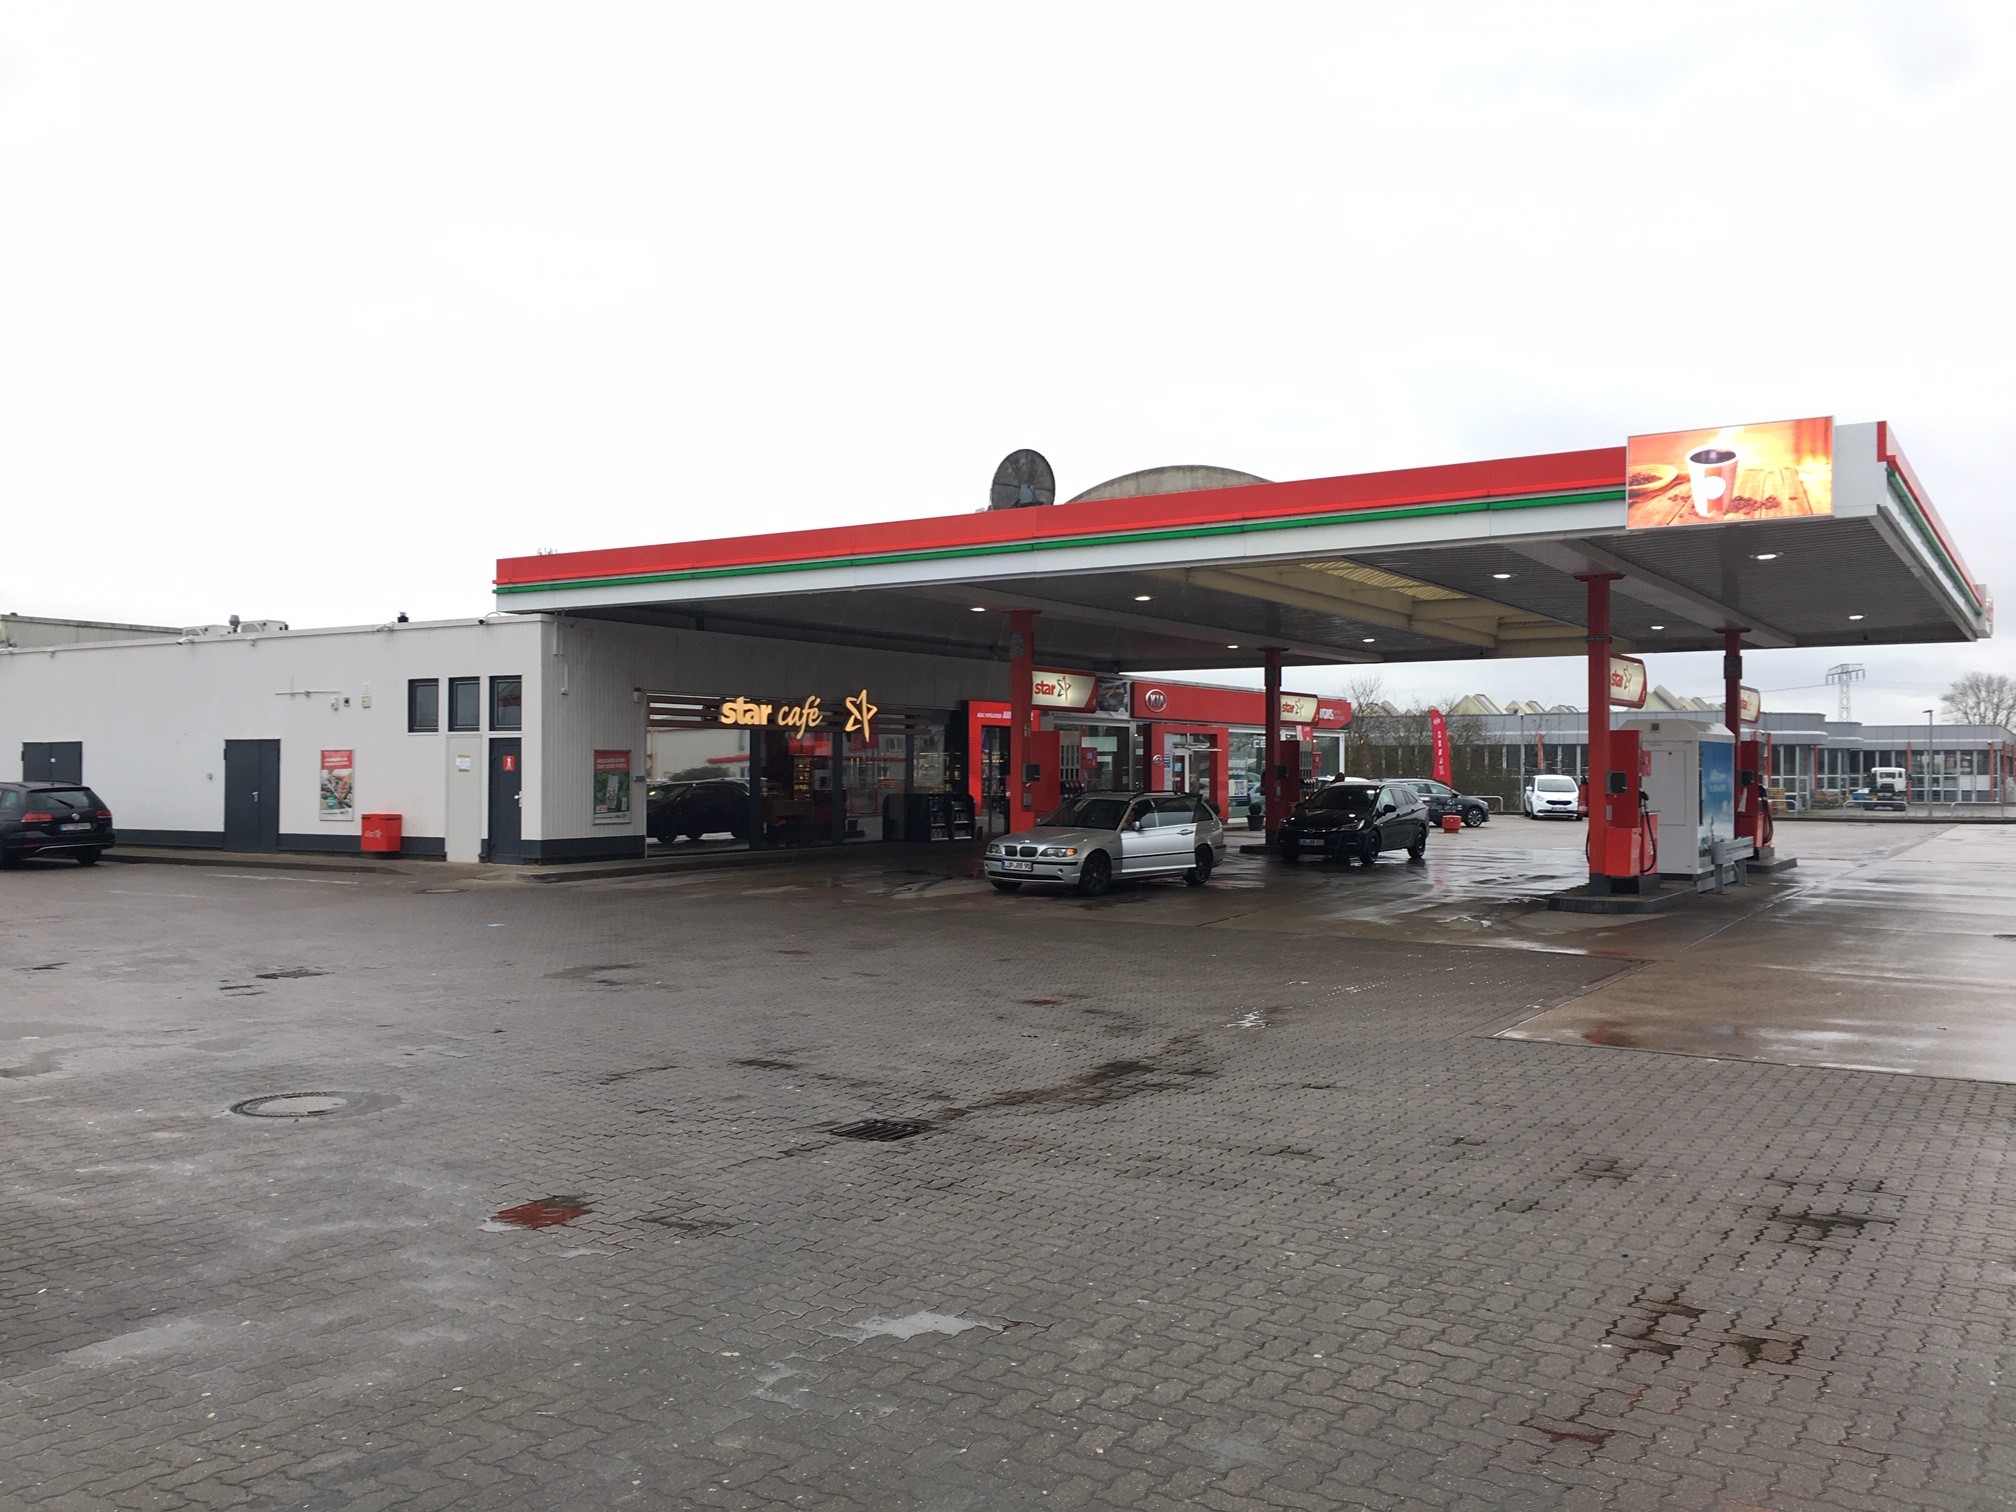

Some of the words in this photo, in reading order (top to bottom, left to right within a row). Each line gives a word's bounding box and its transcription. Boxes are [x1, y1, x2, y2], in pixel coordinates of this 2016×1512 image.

[1034, 680, 1056, 696] star
[1282, 702, 1294, 713] star
[720, 696, 772, 726] star
[777, 695, 822, 740] café
